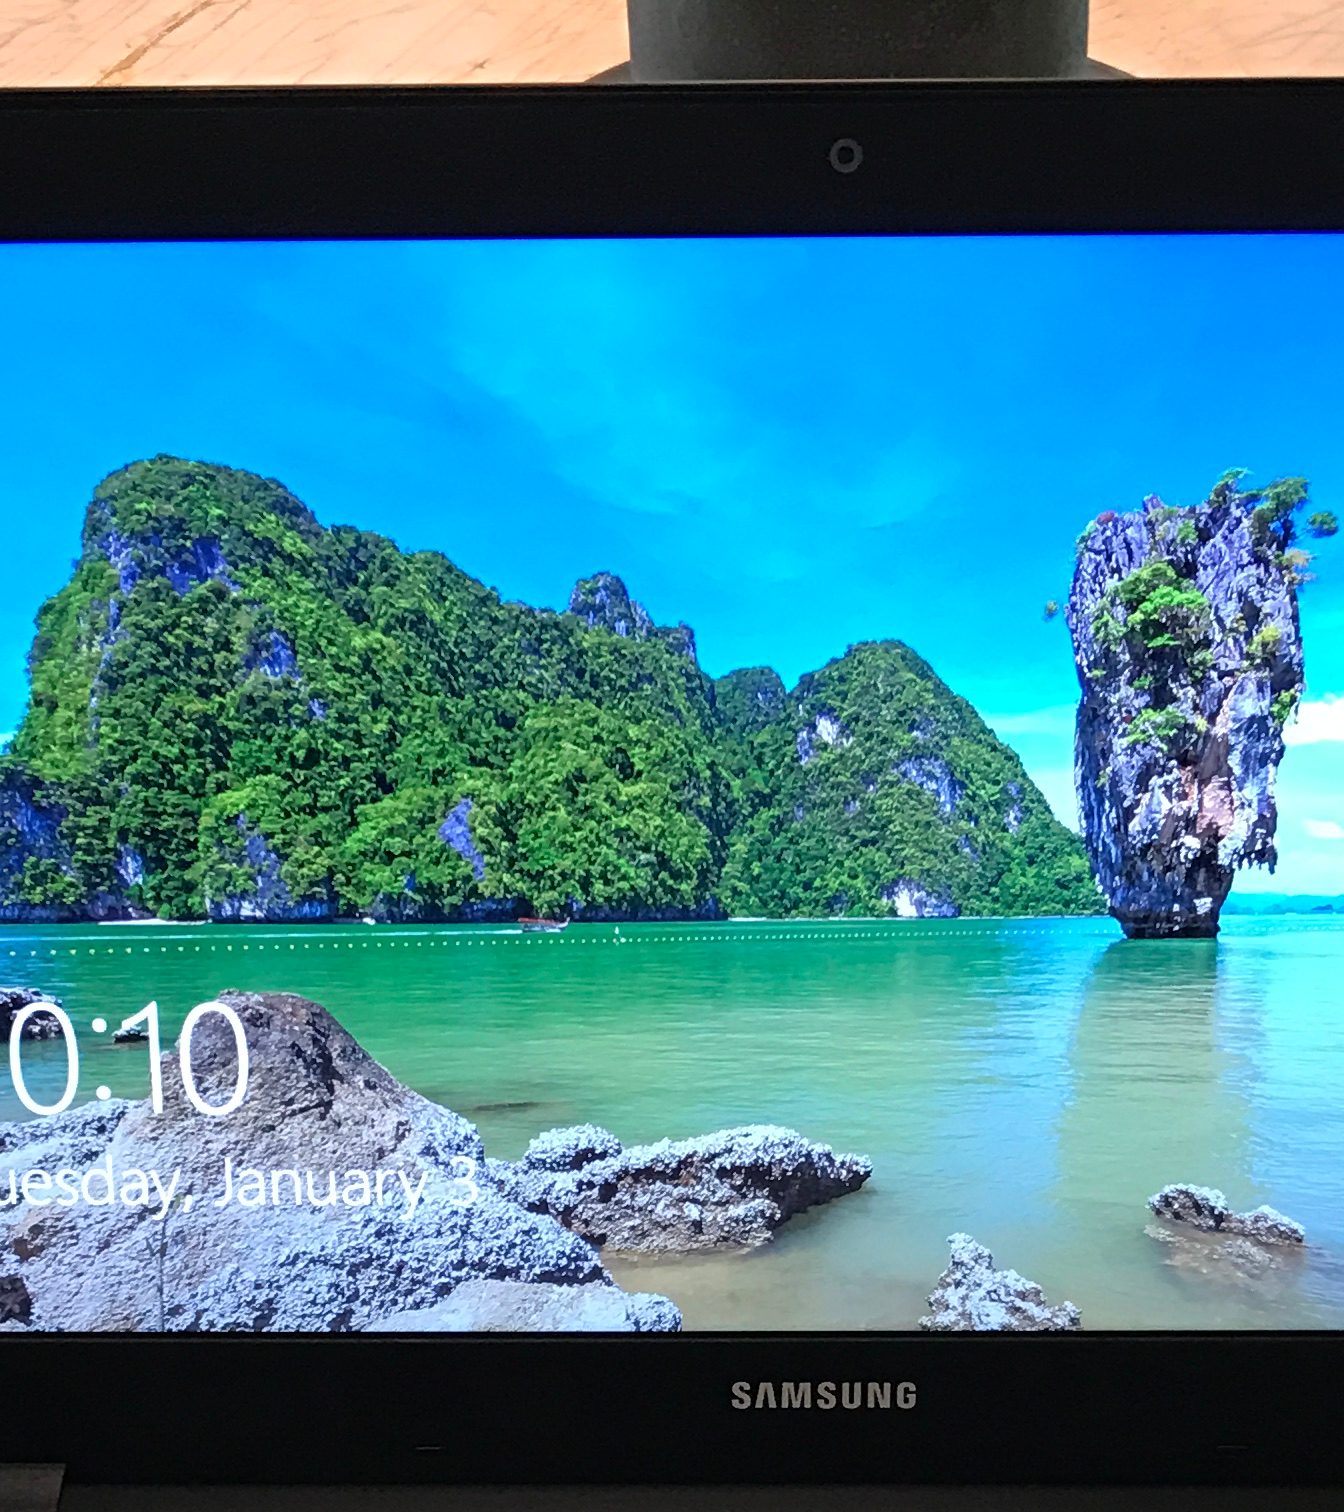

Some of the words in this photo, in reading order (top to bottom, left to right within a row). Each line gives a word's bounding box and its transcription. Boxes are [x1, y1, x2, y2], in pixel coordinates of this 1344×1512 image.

[215, 1156, 430, 1220] January
[450, 1156, 480, 1207] 3
[731, 1381, 918, 1410] SAMSUNG
